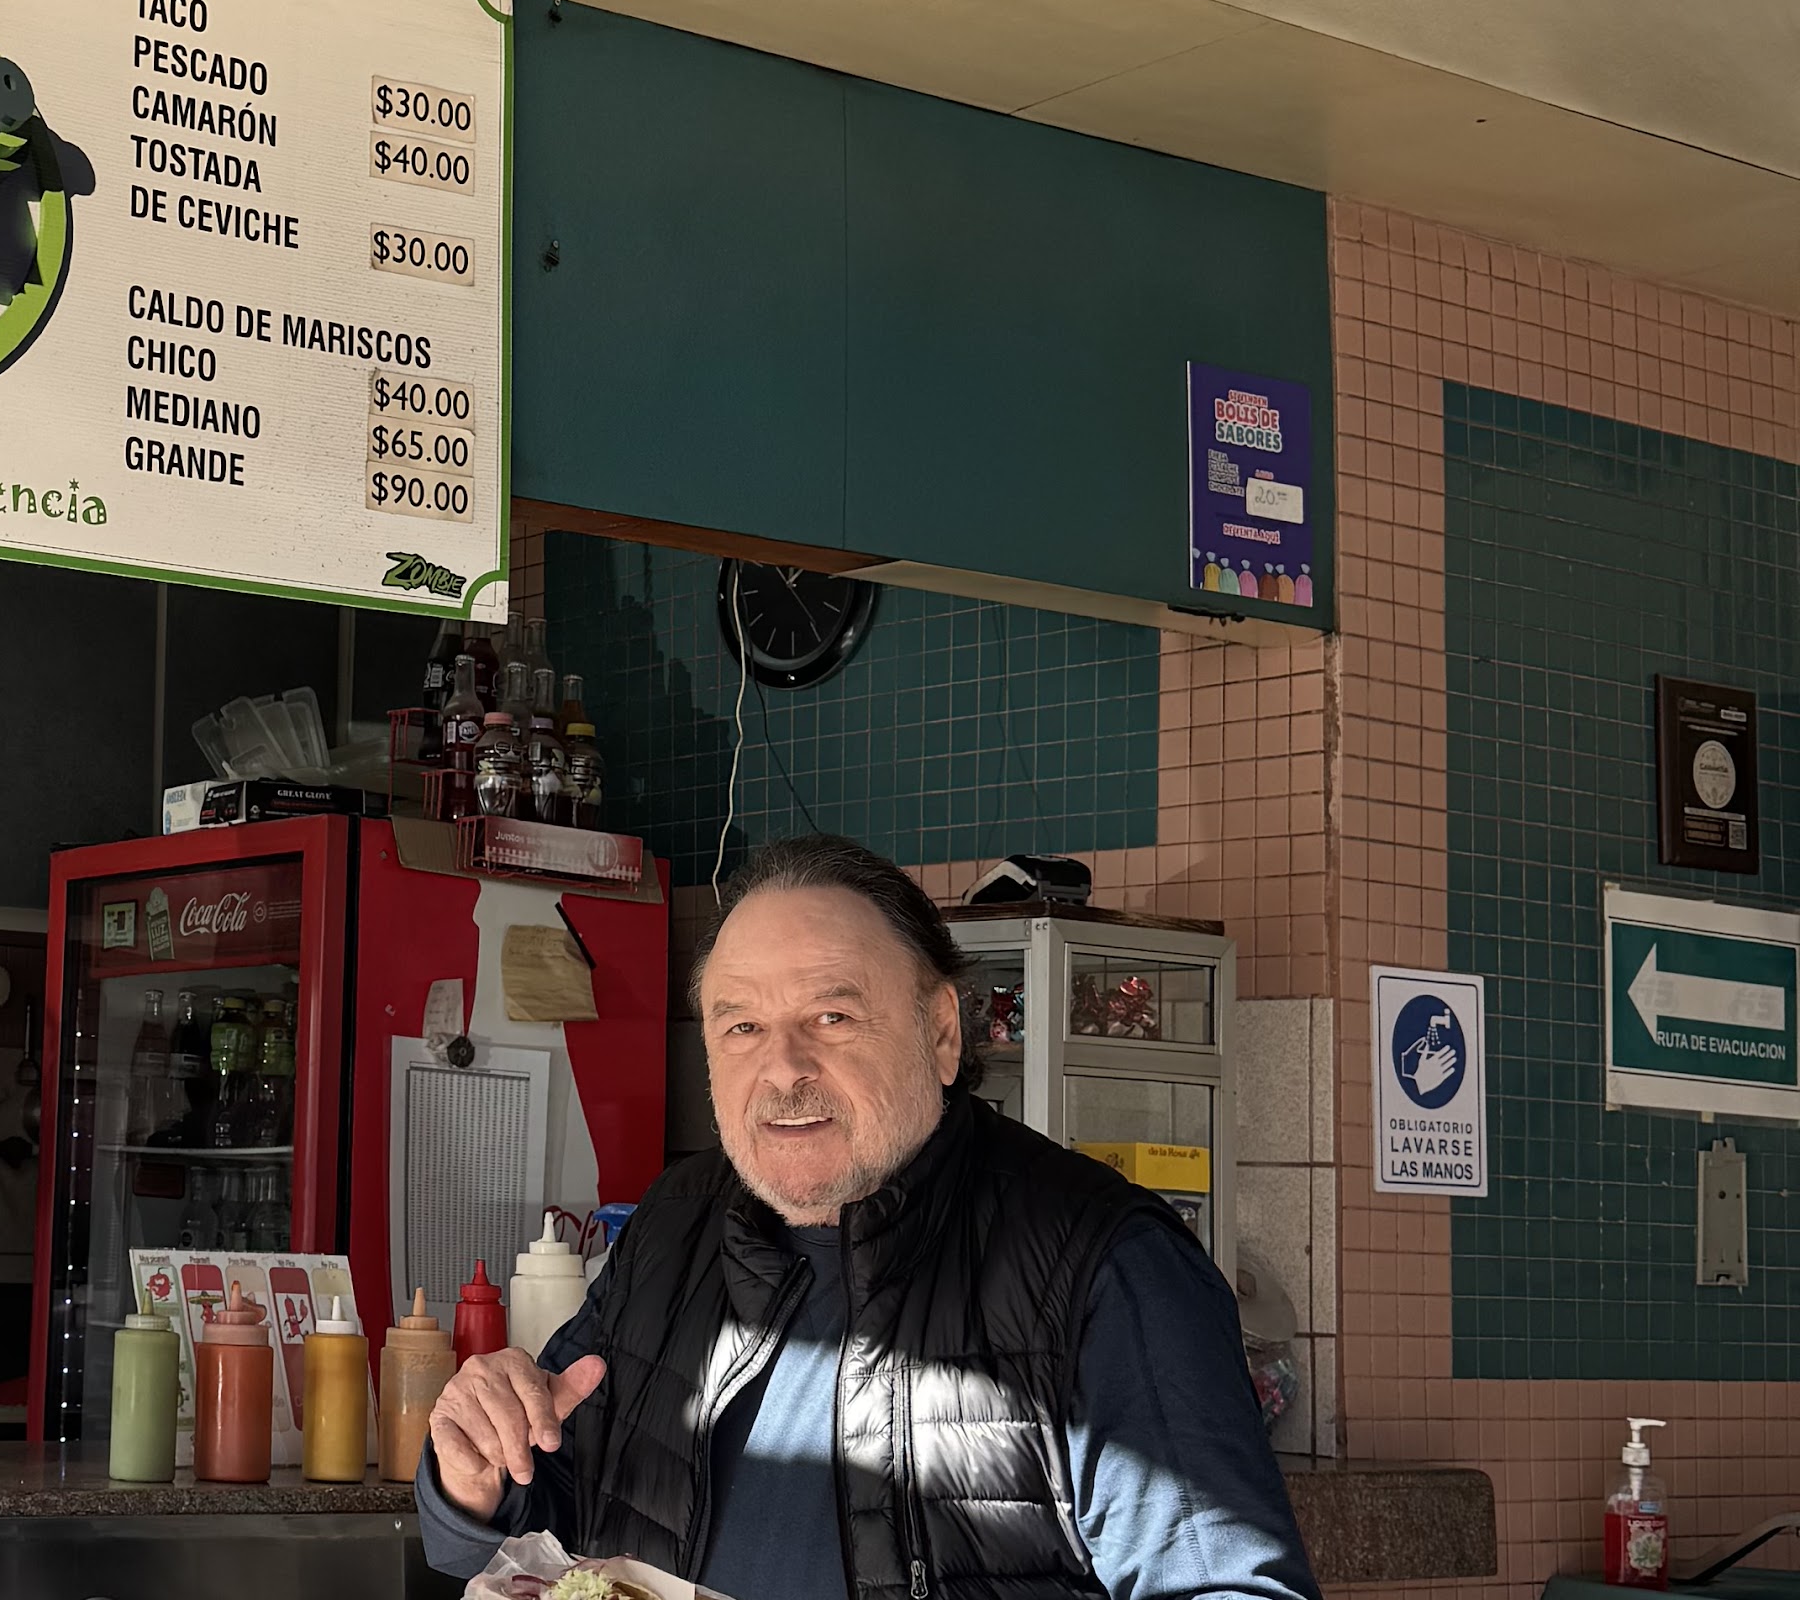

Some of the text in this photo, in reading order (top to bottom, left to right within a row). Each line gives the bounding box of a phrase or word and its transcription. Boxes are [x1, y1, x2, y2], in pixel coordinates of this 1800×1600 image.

[135, 35, 470, 130] PESCADO $30.00
[133, 86, 469, 184] CAMARÓN $40.00
[131, 135, 261, 192] TOSTADA
[131, 185, 468, 274] DE CEVICHE $30.00
[129, 286, 430, 368] CALDO DE MARISCOS
[128, 336, 469, 419] CHICO $40.00
[127, 386, 468, 466] MEDIANO $65.00
[1215, 399, 1278, 429] BOLIS DE
[1216, 421, 1281, 451] SABORES
[126, 437, 468, 514] GRANDE $90.00
[382, 552, 466, 598] ZOMBIE
[180, 892, 252, 937] Coca-Cola
[1656, 1030, 1786, 1061] RUTA DE EVACUACION
[1389, 1118, 1473, 1135] OBLIGATORIO
[1390, 1137, 1473, 1158] LAVARSE
[1391, 1159, 1473, 1181] LAS MANOS
